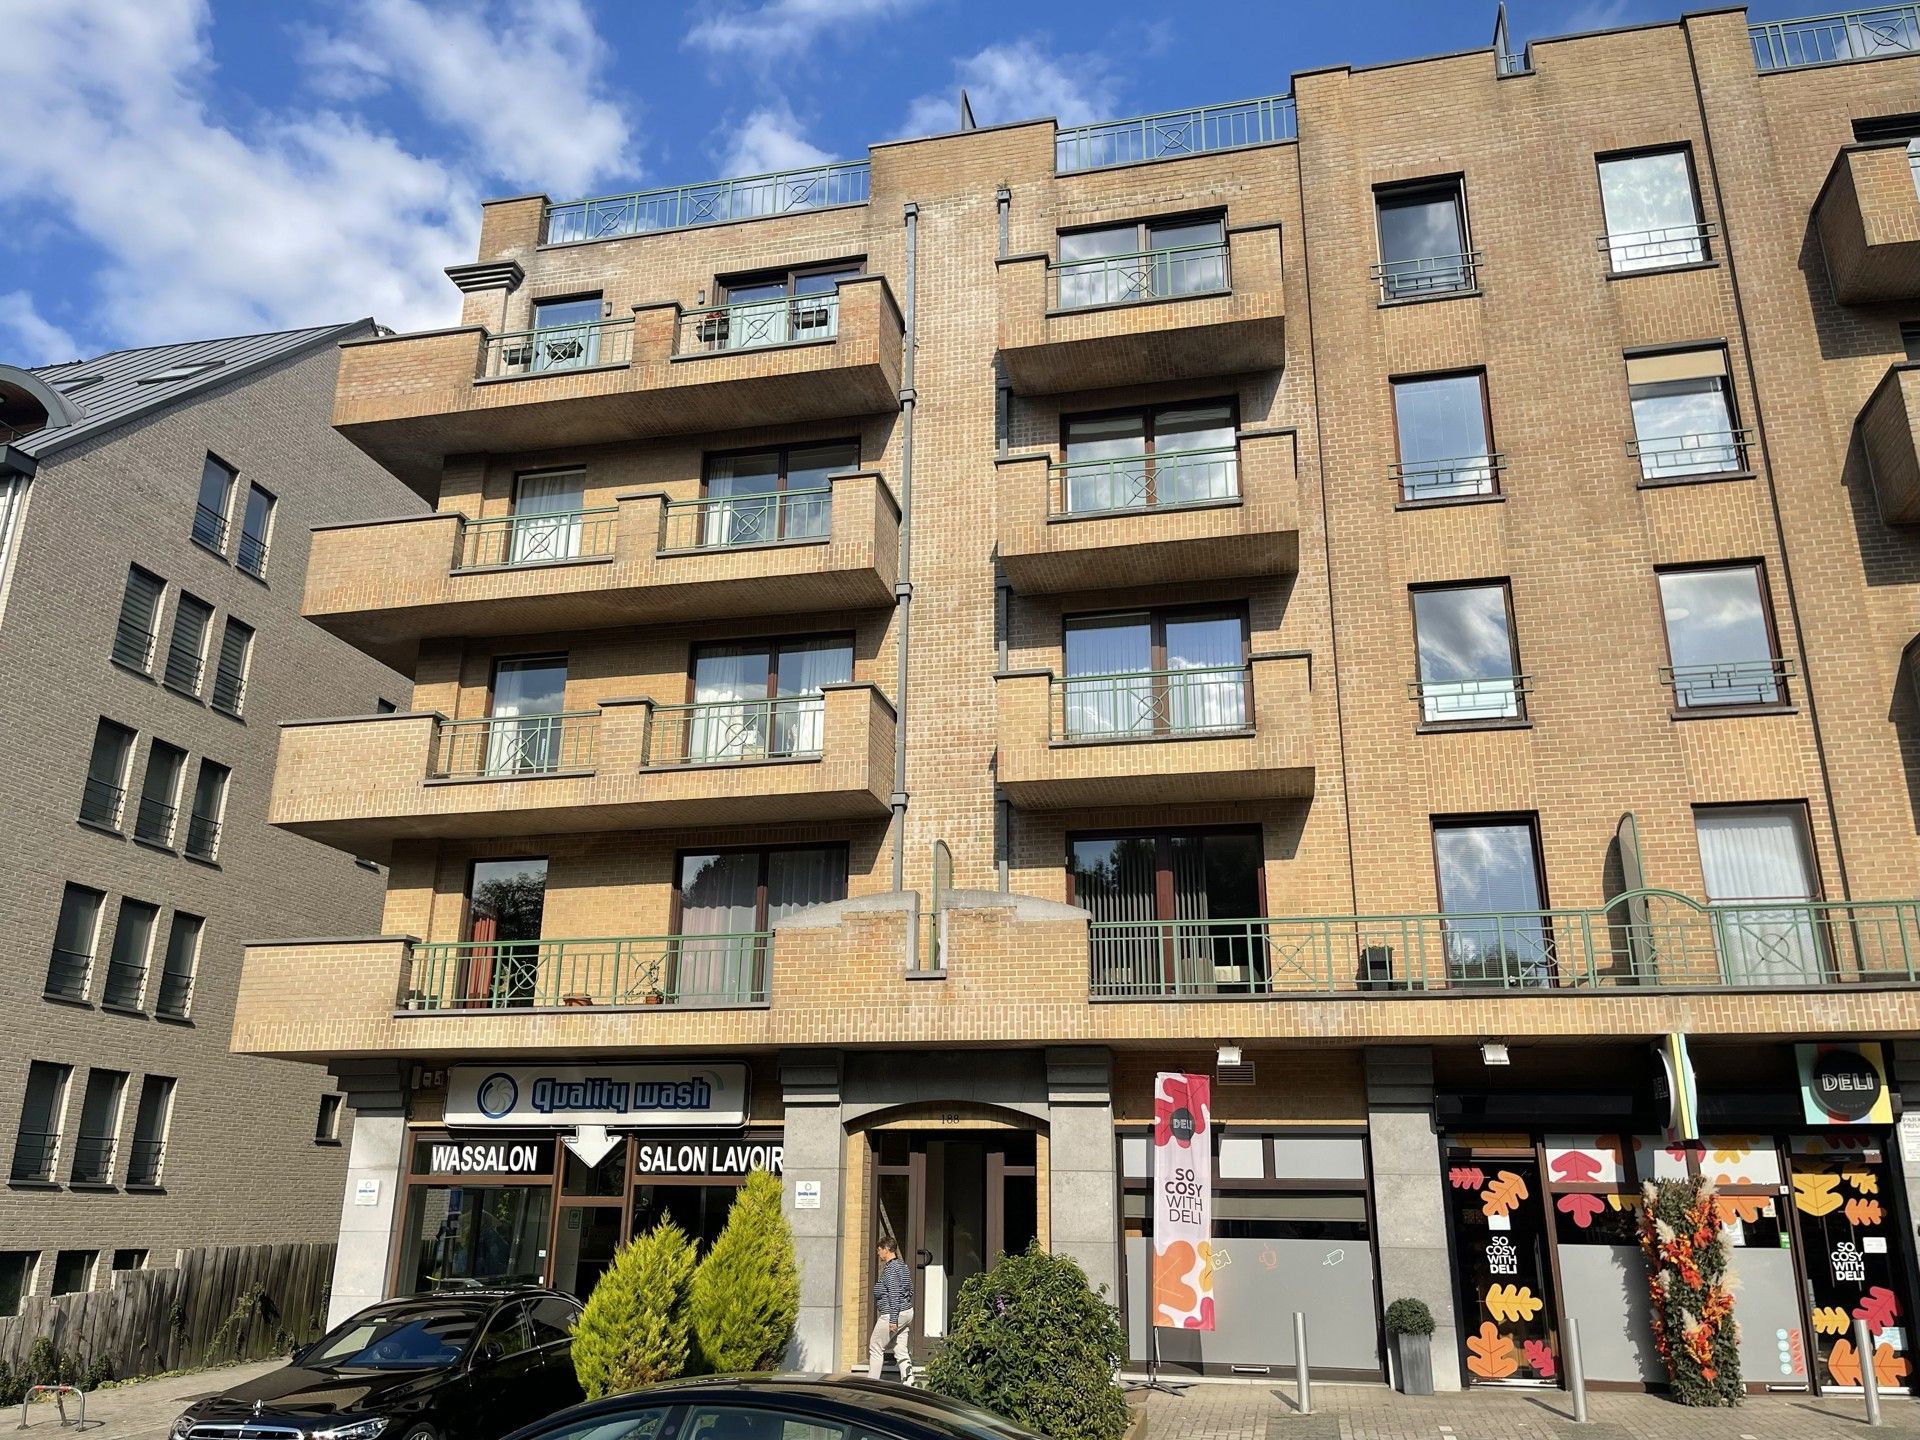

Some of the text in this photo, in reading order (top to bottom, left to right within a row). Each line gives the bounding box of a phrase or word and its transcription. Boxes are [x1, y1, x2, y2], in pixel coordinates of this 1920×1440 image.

[1822, 1073, 1874, 1091] DELI
[634, 1077, 711, 1109] wash
[942, 1114, 960, 1125] 188
[1173, 1118, 1192, 1130] DELI
[432, 1145, 538, 1171] WASSALON
[639, 1145, 784, 1172] SALON LAVOIR
[1175, 1168, 1195, 1182] SO
[1165, 1181, 1203, 1197] COSY
[1166, 1195, 1203, 1211] WITH
[1169, 1209, 1202, 1225] DELI
[1492, 1236, 1508, 1246] SO
[1486, 1245, 1517, 1255] COSY
[1837, 1242, 1855, 1252] SO
[1487, 1255, 1517, 1265] WITH
[1831, 1251, 1864, 1262] COSY
[1490, 1264, 1517, 1274] DELI
[1832, 1261, 1865, 1271] WITH
[1836, 1271, 1865, 1281] DELI
